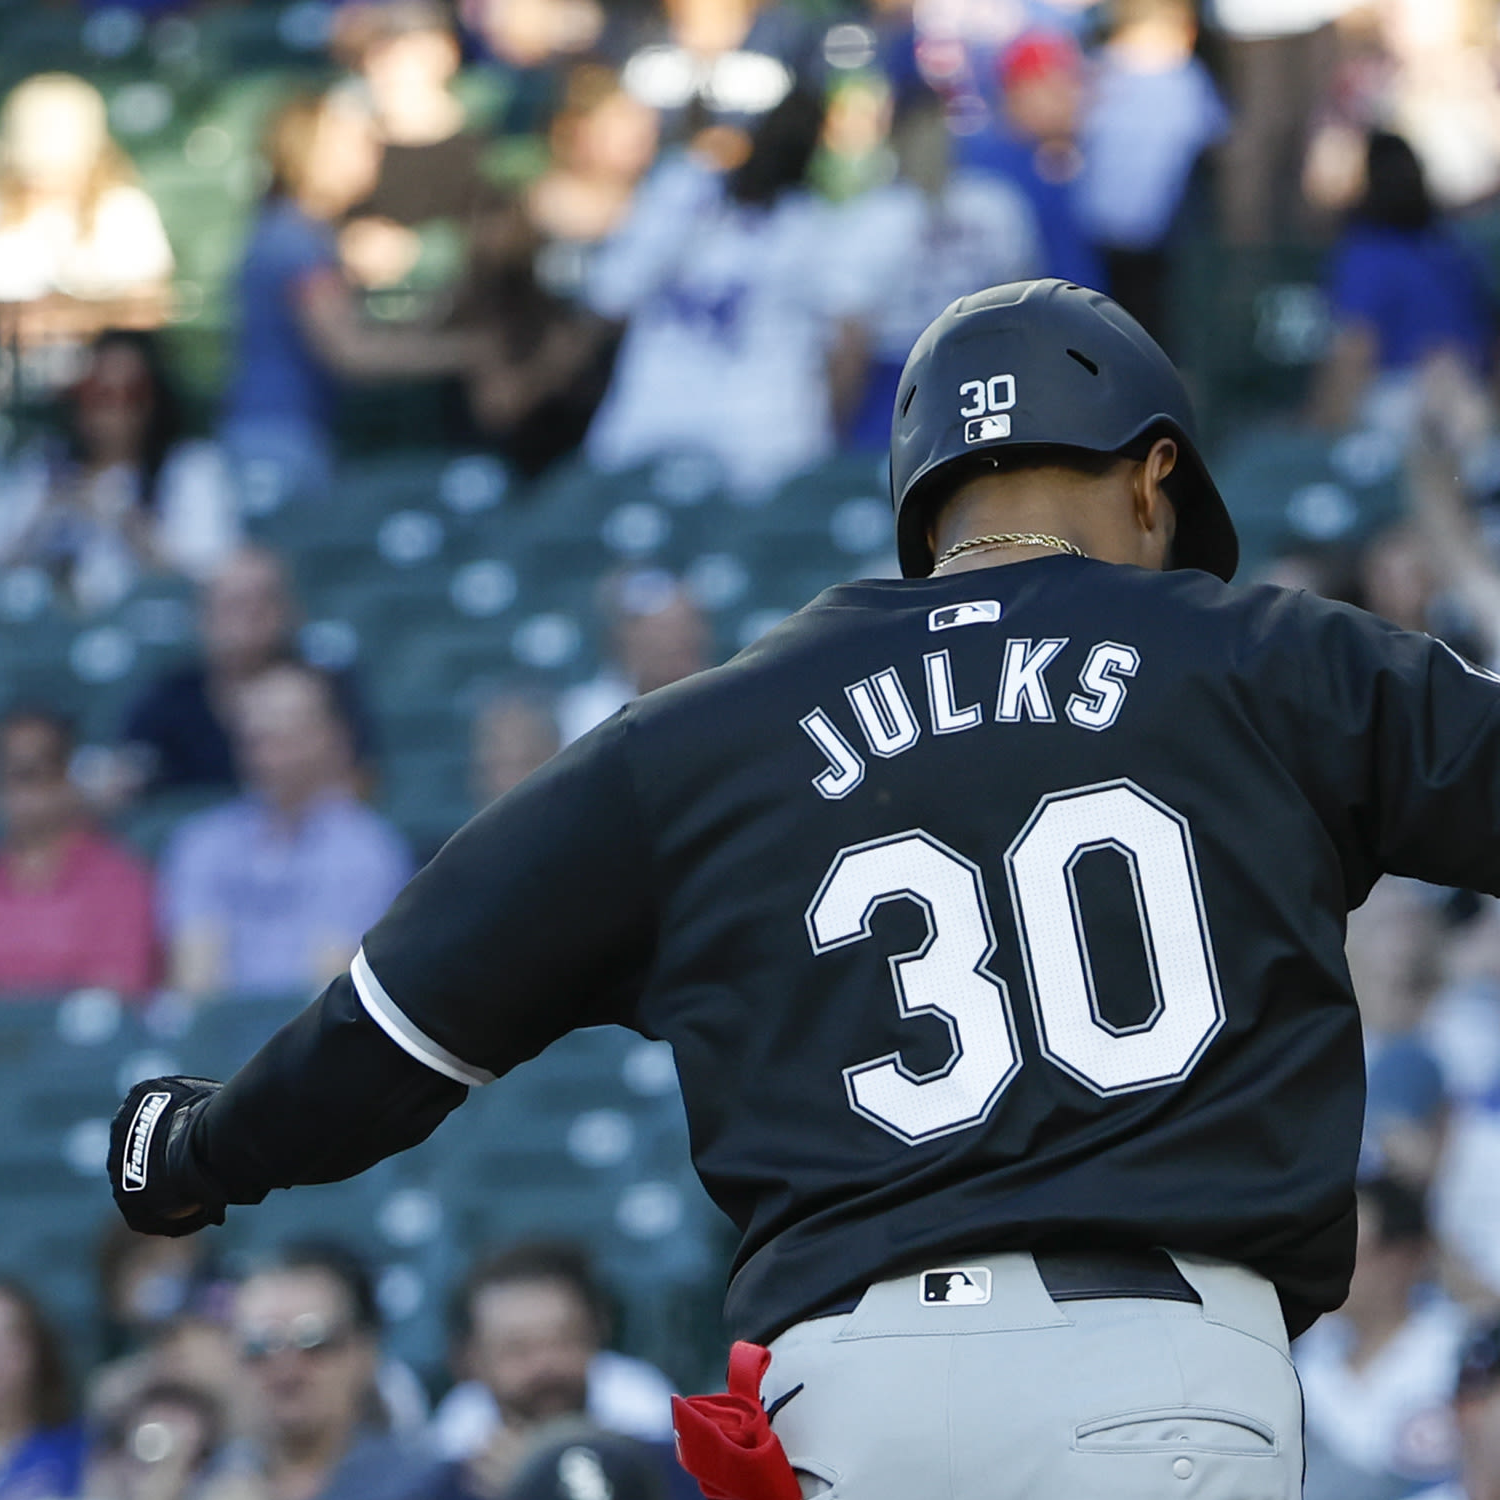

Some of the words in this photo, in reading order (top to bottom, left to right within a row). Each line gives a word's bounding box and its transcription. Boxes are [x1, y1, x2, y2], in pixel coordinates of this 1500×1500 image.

[959, 374, 1017, 417] 30
[799, 638, 1141, 800] JULKS
[804, 777, 1227, 1146] 30
[125, 1095, 164, 1185] Franklin
